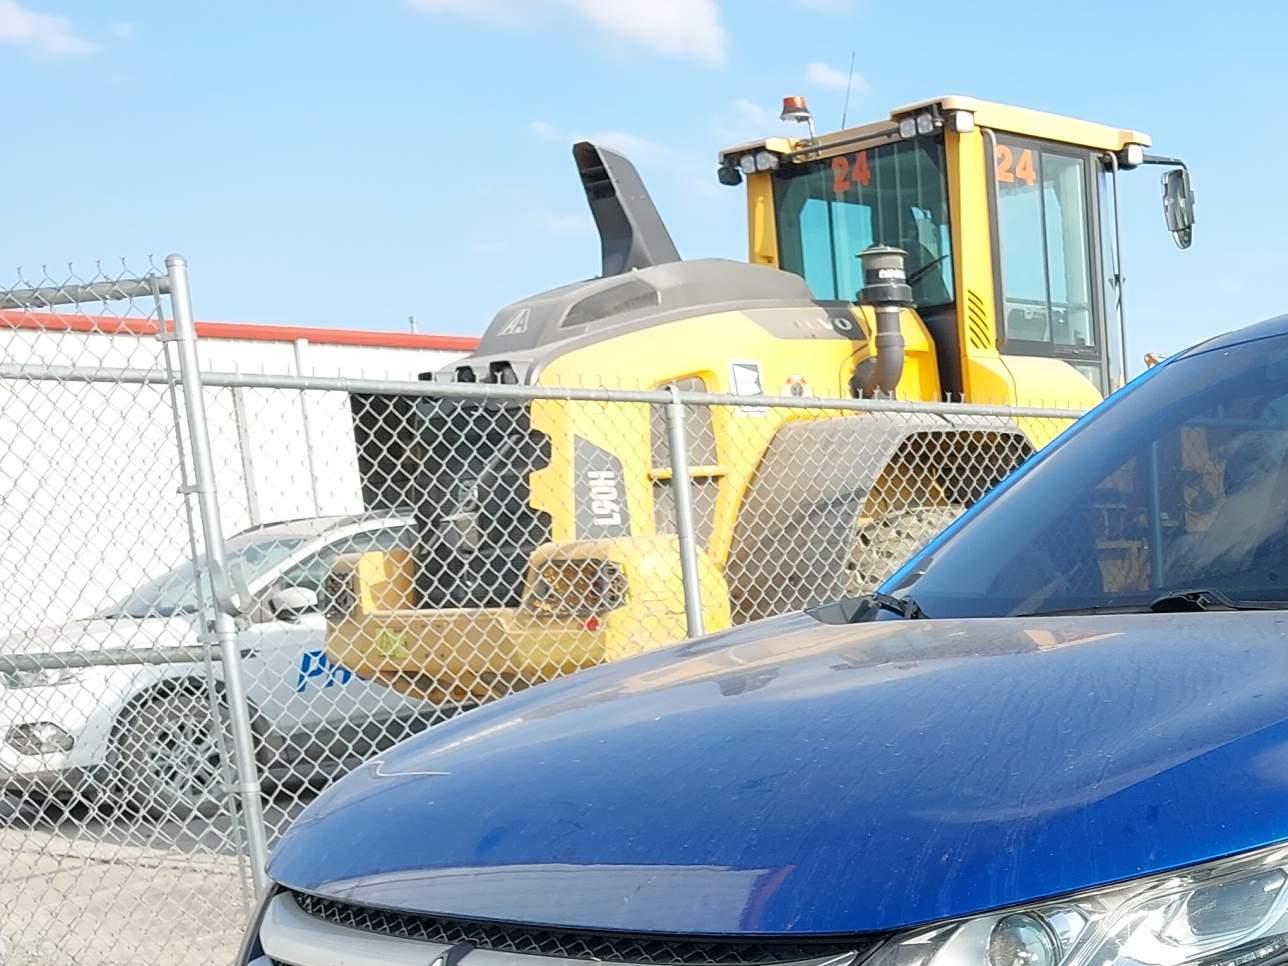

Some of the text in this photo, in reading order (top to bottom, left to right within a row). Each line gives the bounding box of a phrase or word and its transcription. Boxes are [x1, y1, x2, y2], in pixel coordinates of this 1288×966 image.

[830, 150, 871, 194] 24
[994, 144, 1047, 186] 24
[586, 470, 622, 526] L90H
